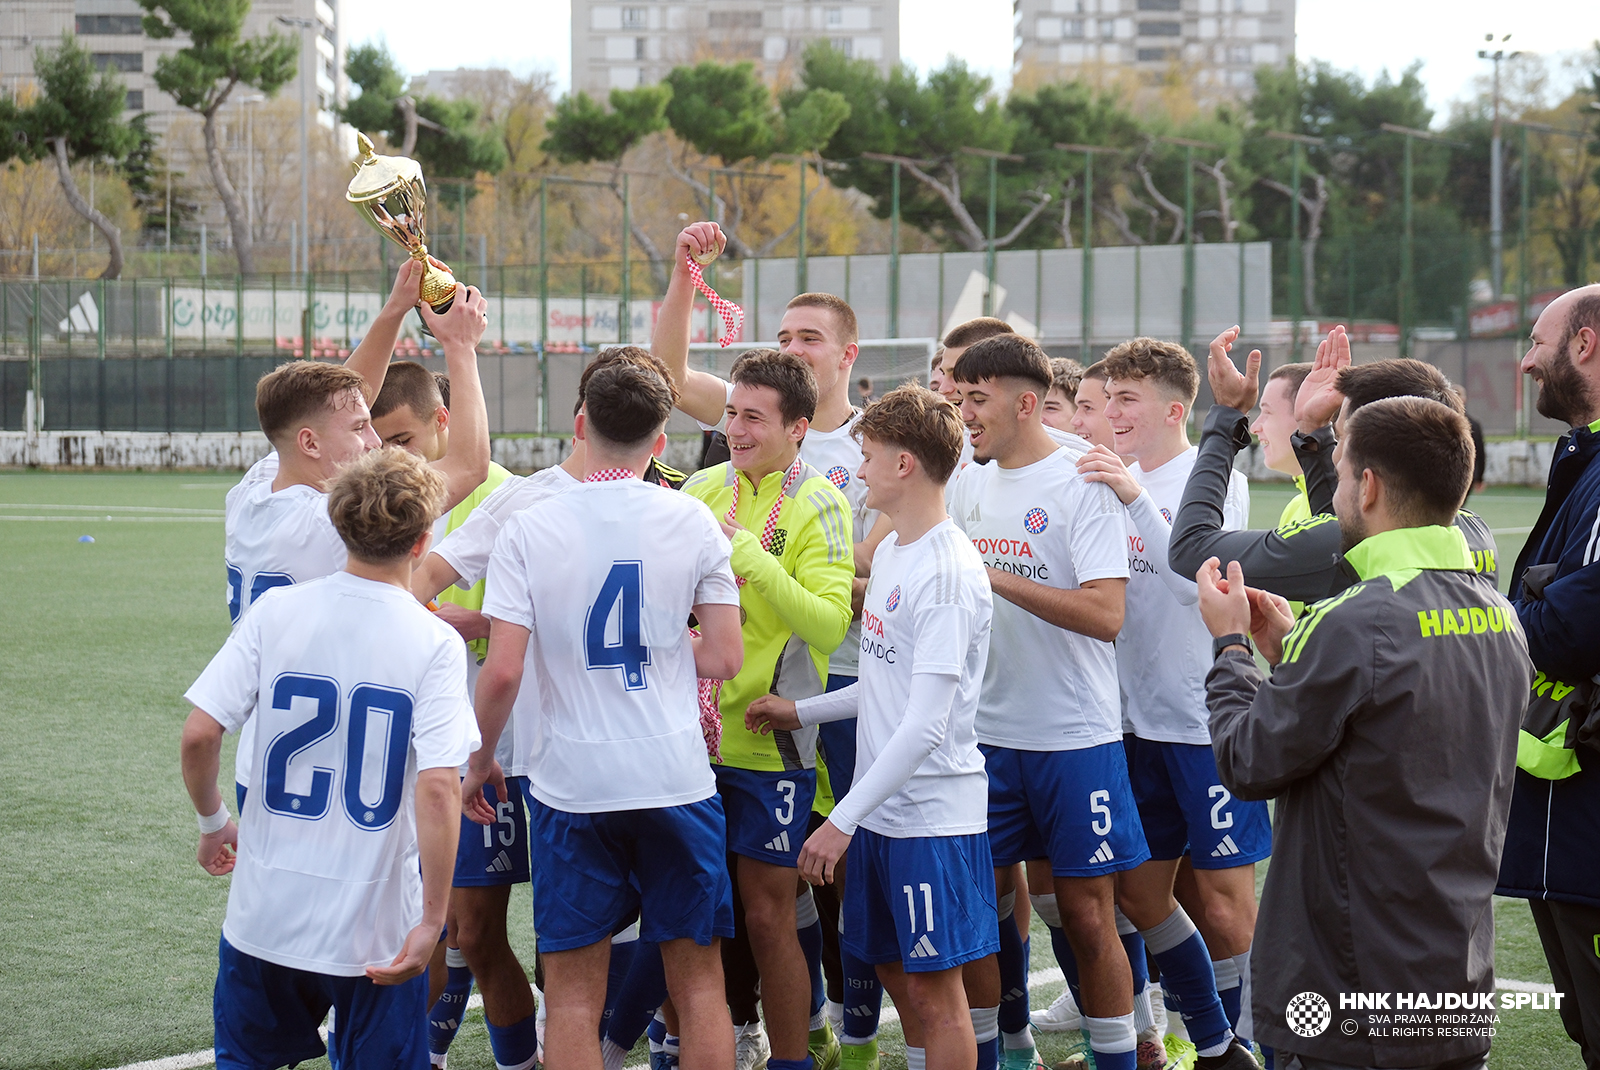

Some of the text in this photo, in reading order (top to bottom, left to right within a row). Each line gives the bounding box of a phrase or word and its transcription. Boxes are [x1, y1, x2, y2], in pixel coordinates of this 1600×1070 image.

[583, 560, 651, 691] 4
[1417, 607, 1516, 638] HAJDUK
[262, 671, 415, 831] 20
[775, 780, 796, 825] 3
[1090, 789, 1112, 836] 5
[1208, 784, 1233, 829] 2
[903, 883, 934, 933] 11
[847, 977, 874, 989] 1911
